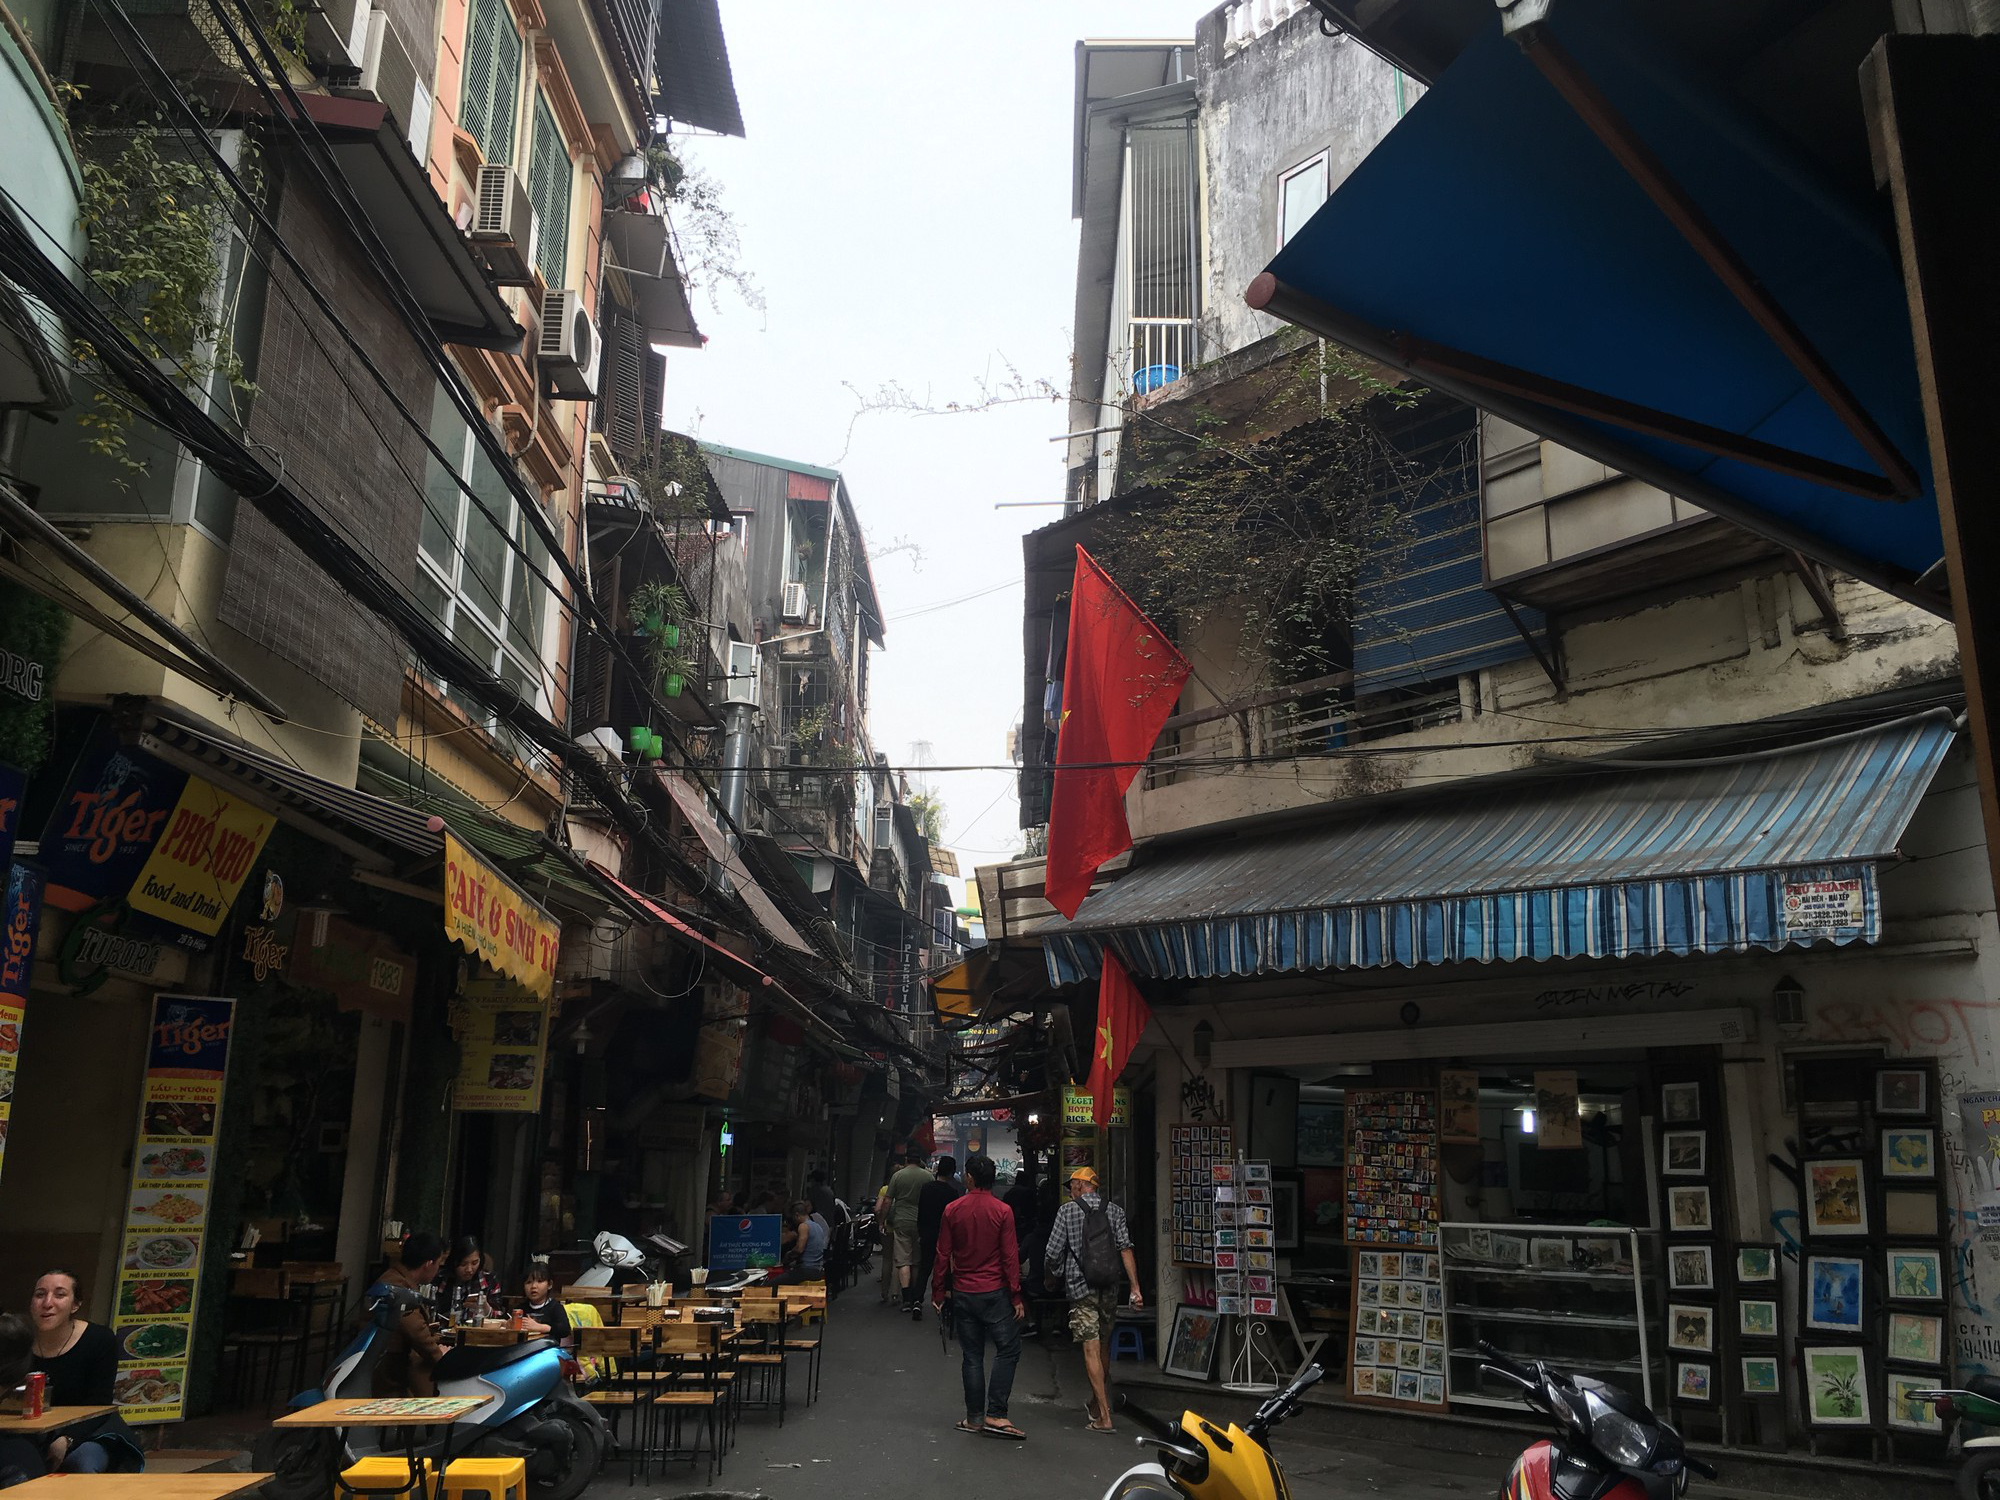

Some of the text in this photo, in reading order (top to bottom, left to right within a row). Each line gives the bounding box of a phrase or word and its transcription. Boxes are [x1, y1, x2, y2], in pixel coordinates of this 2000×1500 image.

[64, 788, 168, 864] Tiger
[142, 874, 221, 920] Food and Drink
[1, 893, 32, 988] Tiger
[75, 926, 161, 975] TUBORG
[242, 925, 288, 982] Tiger
[489, 895, 502, 938] &
[505, 907, 536, 966] SINH
[372, 960, 400, 993] 1983
[153, 1015, 232, 1055] Tiger
[1065, 1097, 1126, 1106] VEGETNS
